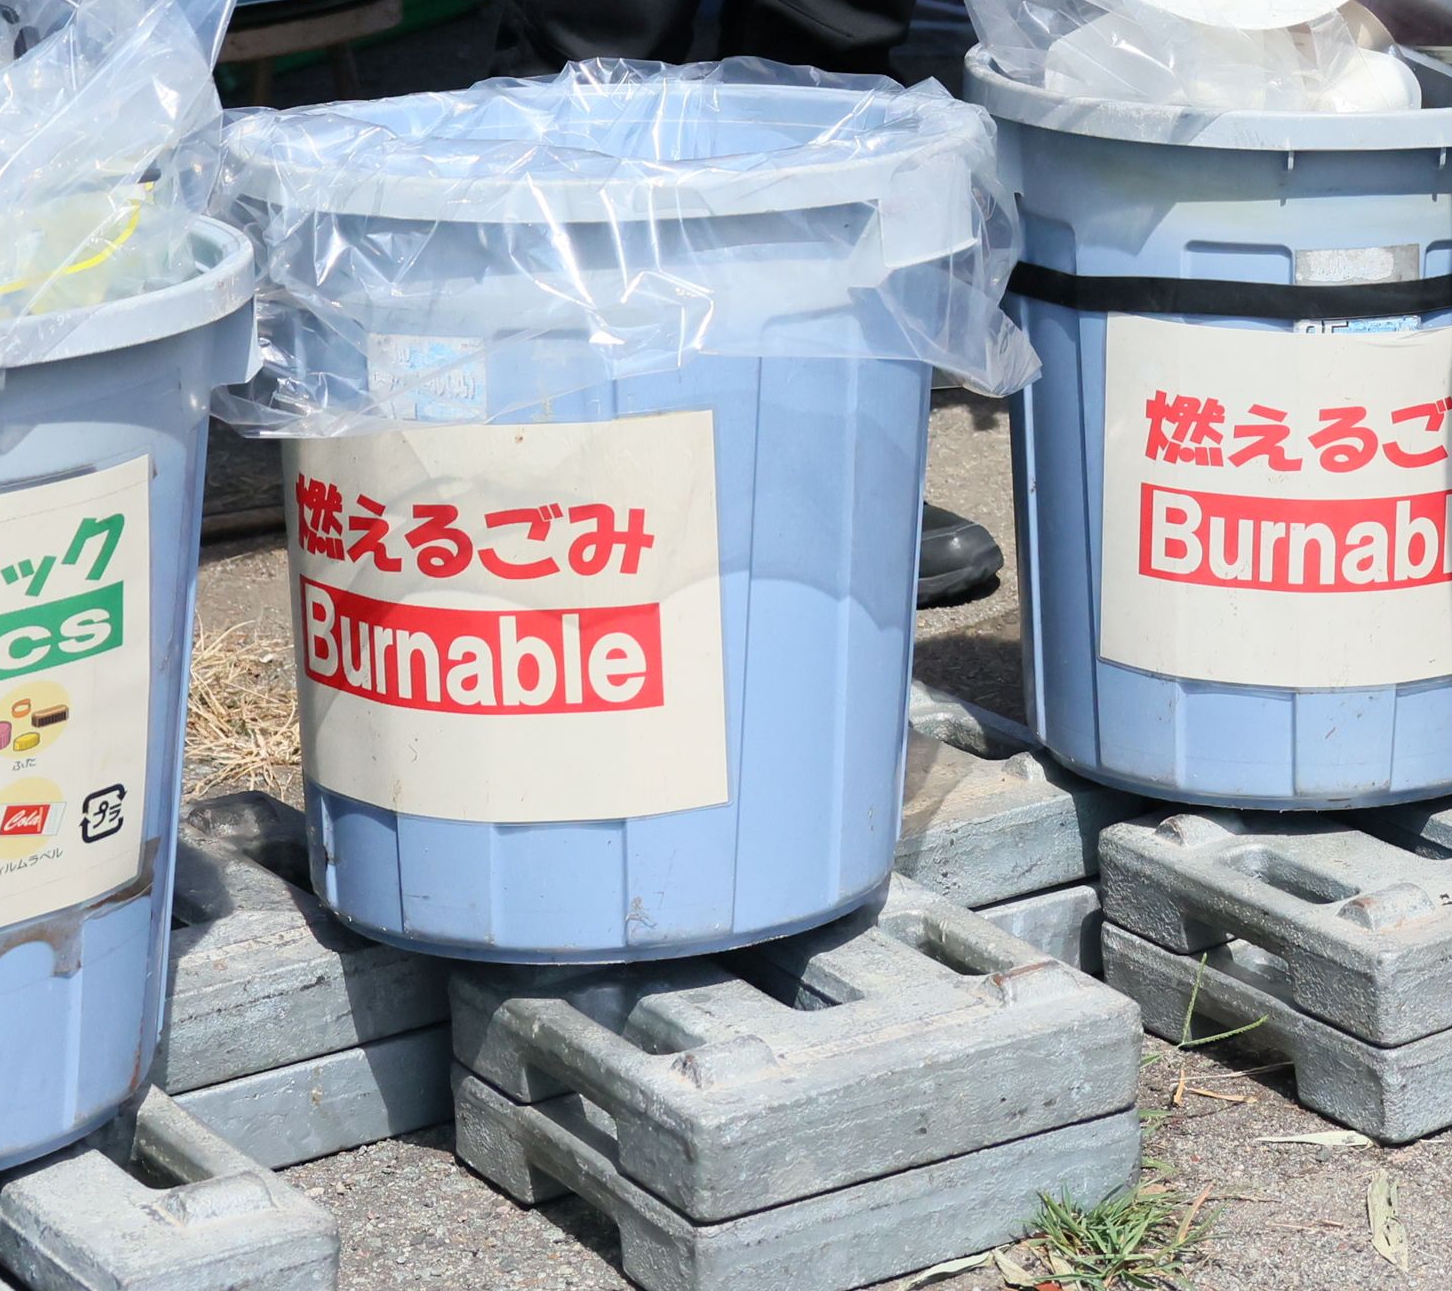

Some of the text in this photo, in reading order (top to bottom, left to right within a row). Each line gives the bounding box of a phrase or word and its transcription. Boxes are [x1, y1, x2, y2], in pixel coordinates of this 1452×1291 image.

[295, 472, 655, 580] 燃えるごみ
[304, 580, 648, 707] Burnable
